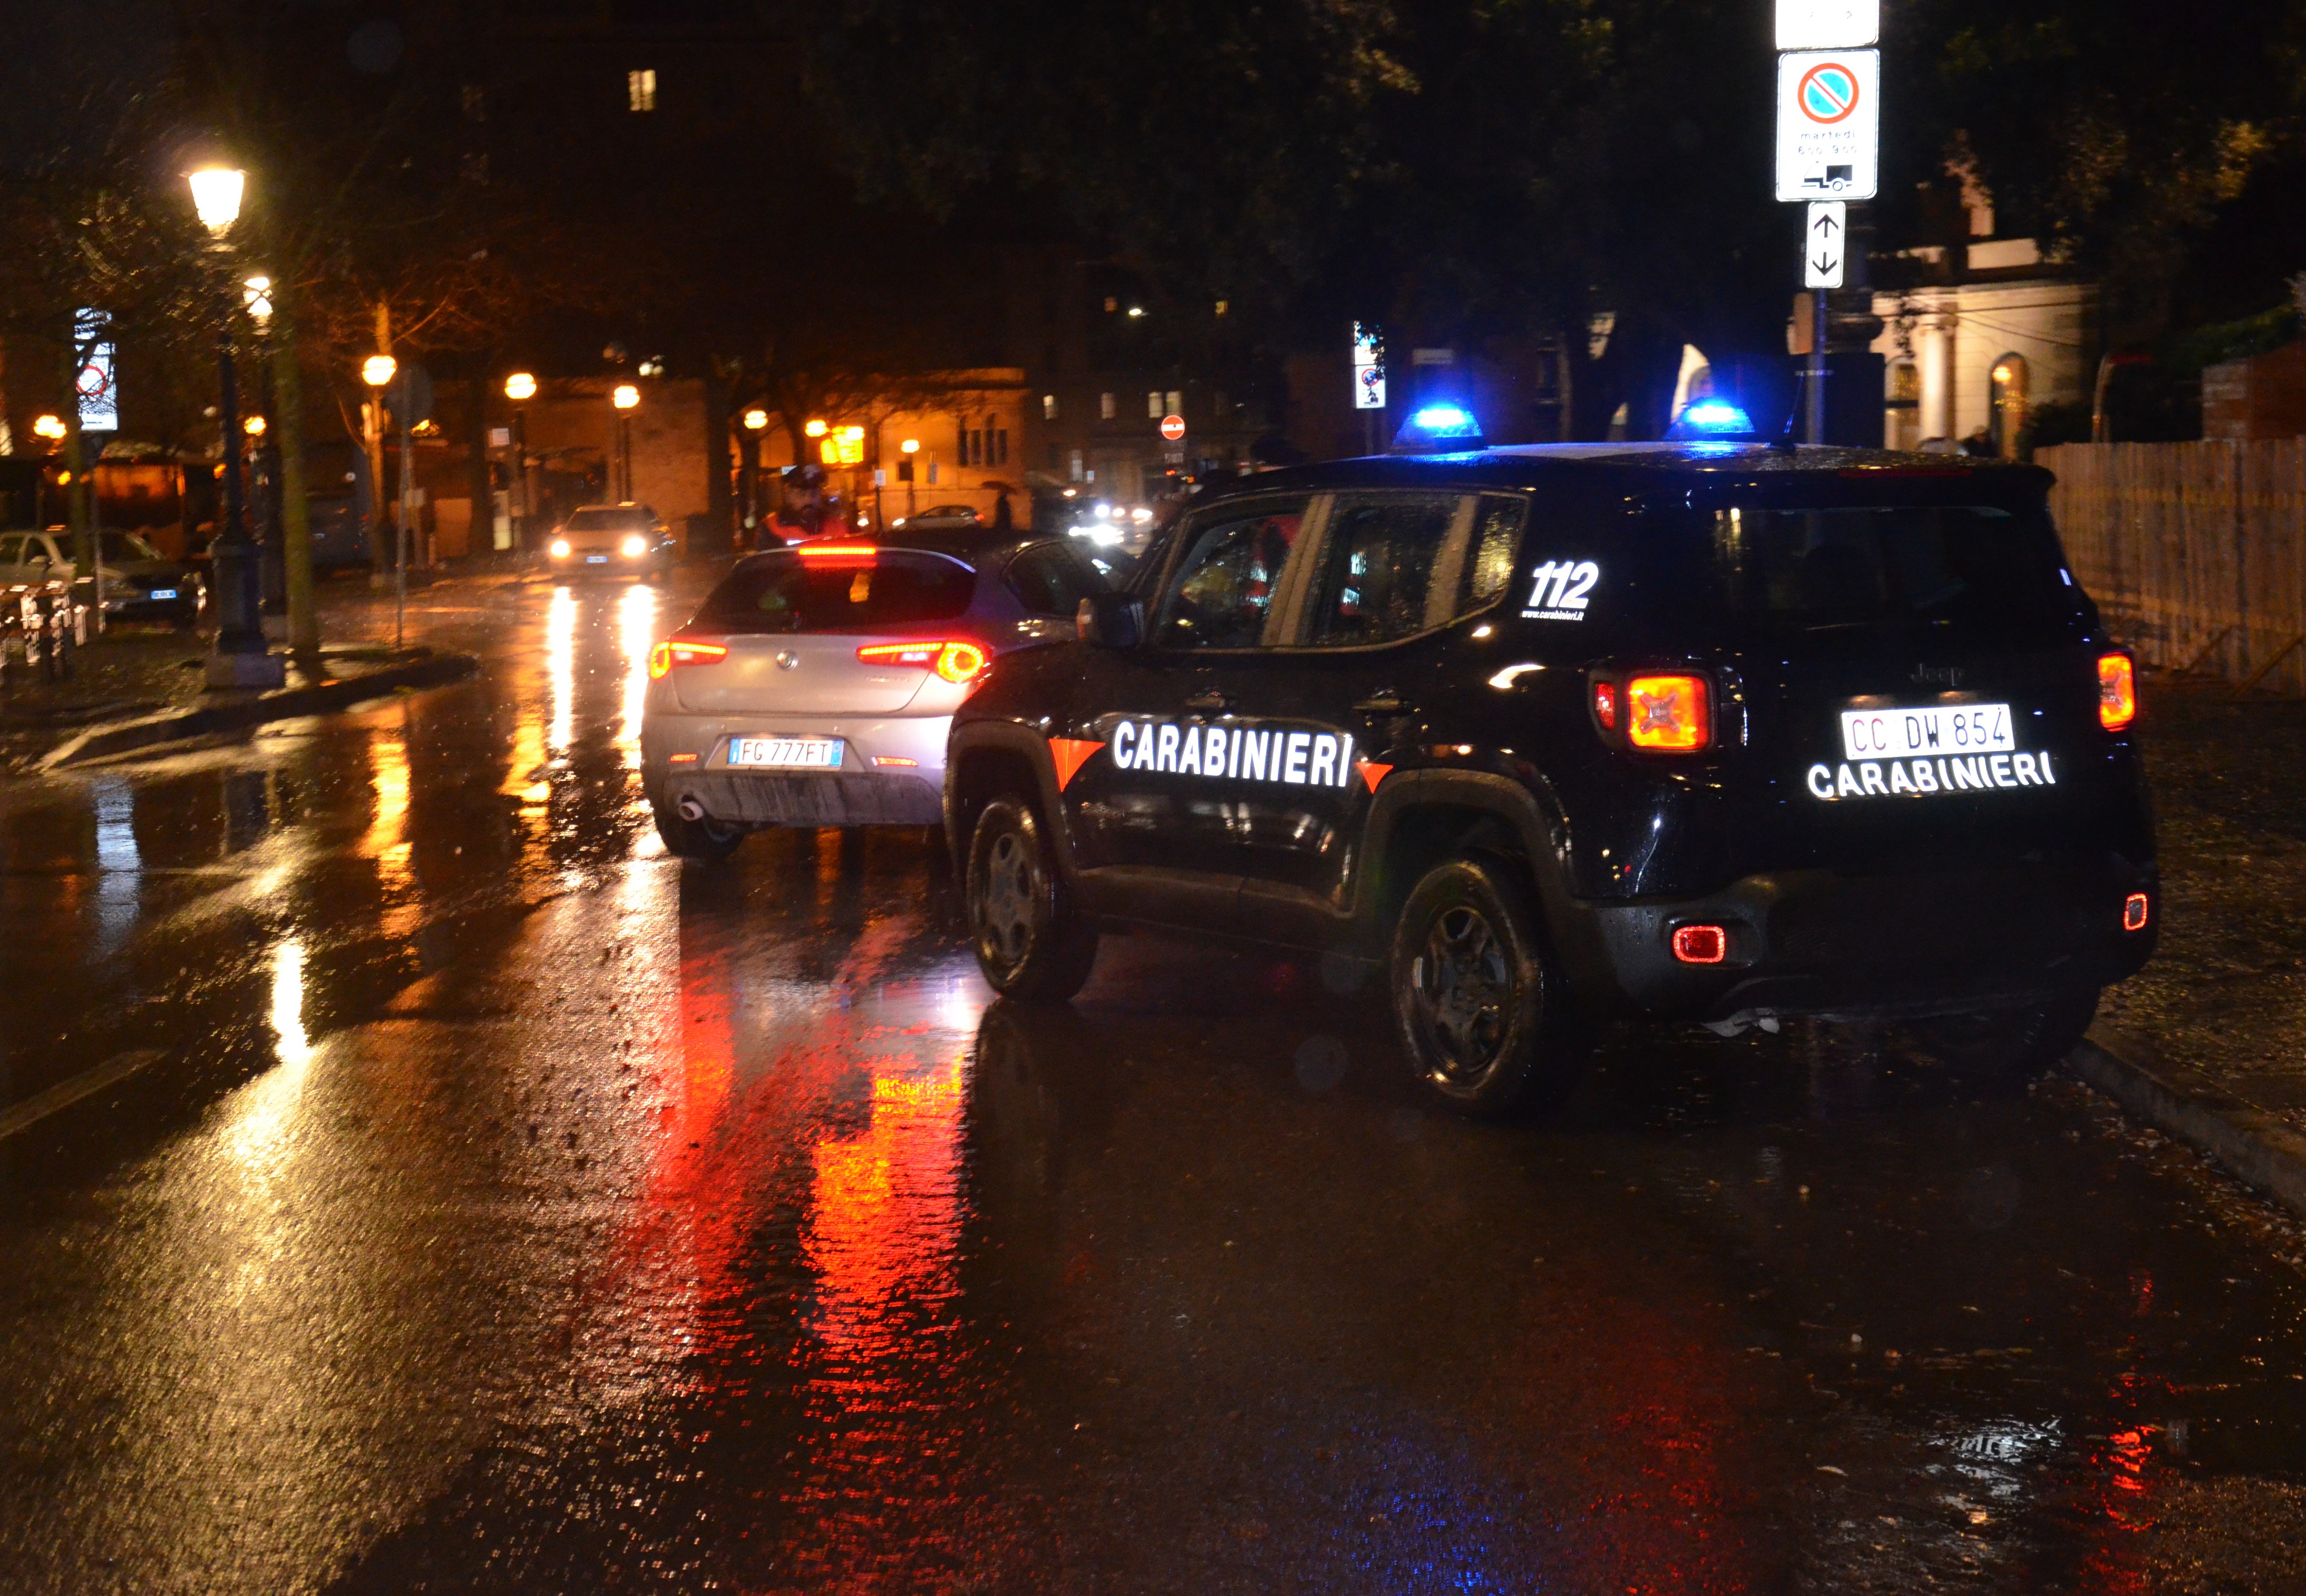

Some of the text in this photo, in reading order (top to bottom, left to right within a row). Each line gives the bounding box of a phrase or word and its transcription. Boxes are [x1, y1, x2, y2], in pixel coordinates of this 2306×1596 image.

[1529, 561, 1599, 609] 112
[1522, 610, 1584, 621] www.carabinieri.it
[742, 742, 828, 762] FG 777FT
[1852, 711, 2005, 752] CC DW 854
[1114, 721, 1353, 787] CARABINIERI
[1808, 751, 2056, 798] CARABINIERI
